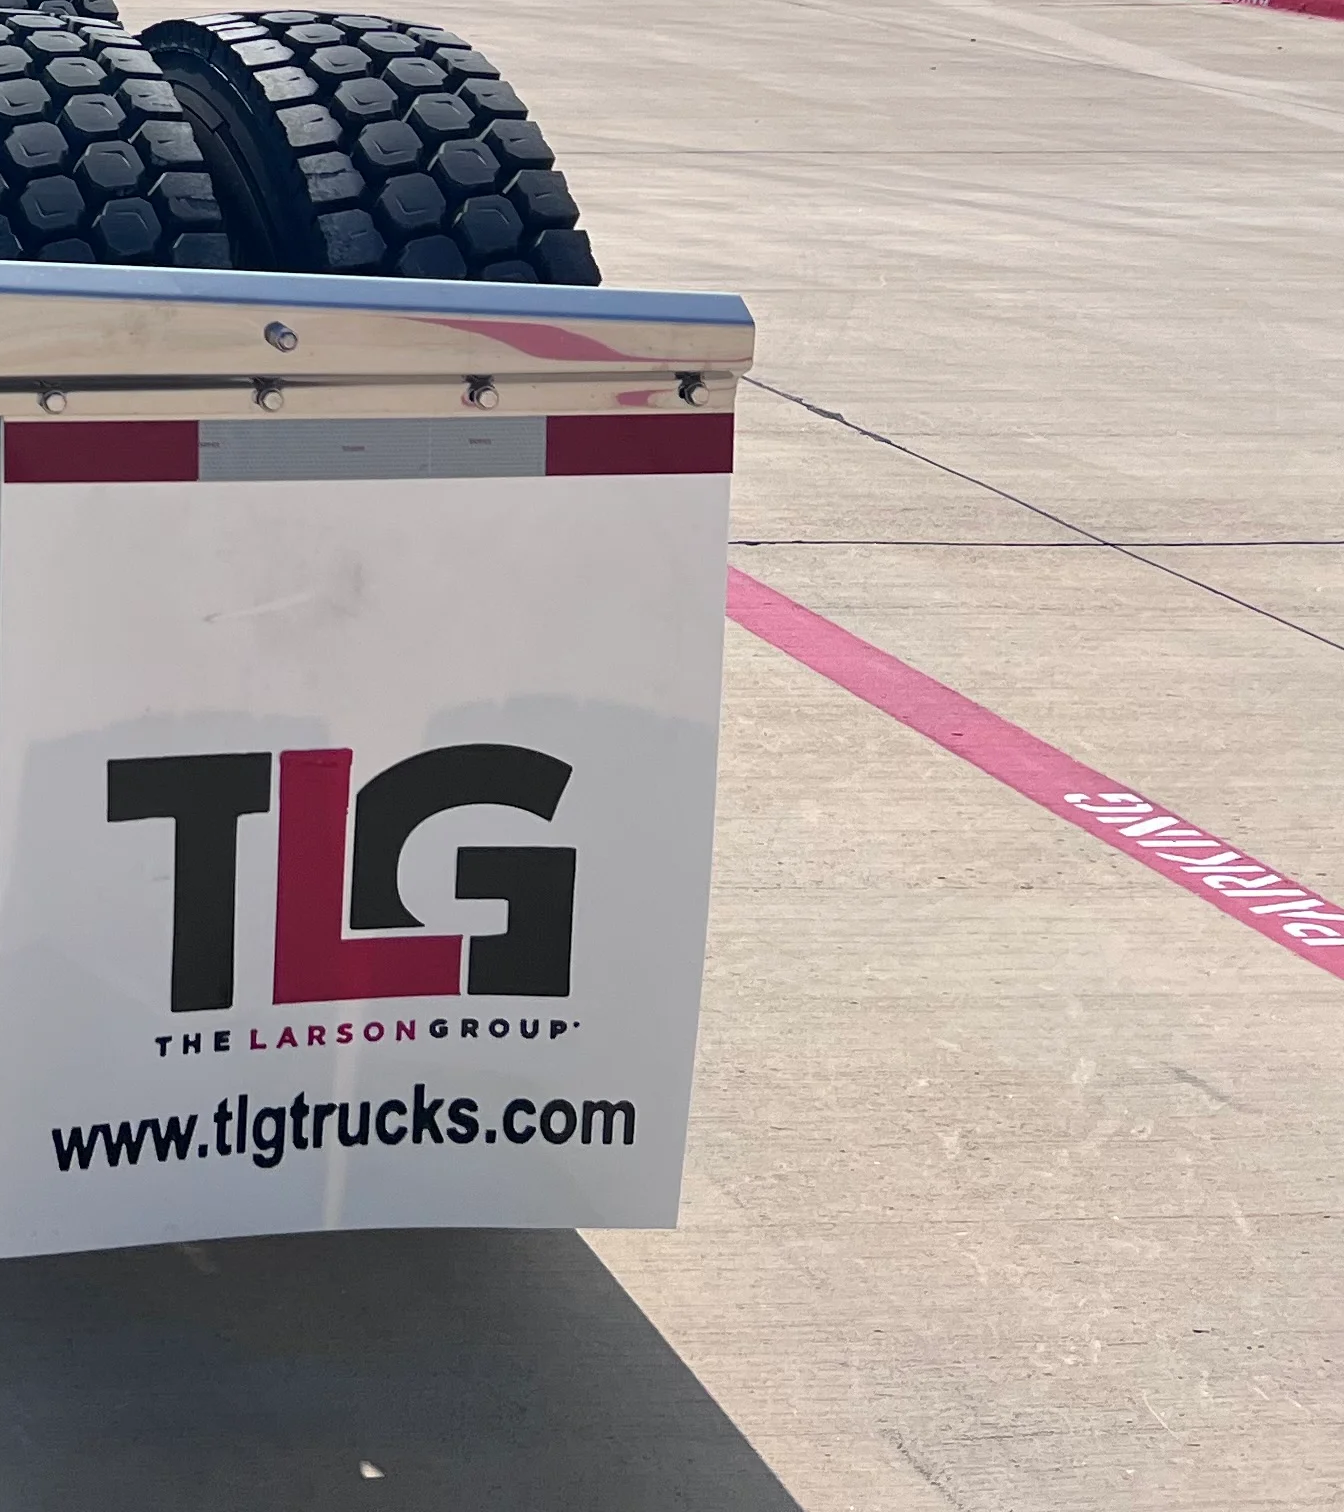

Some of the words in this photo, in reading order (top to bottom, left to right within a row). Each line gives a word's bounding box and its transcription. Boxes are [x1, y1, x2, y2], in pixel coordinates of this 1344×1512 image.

[106, 743, 578, 1014] TLG
[154, 1030, 232, 1058] THE
[51, 1083, 636, 1172] www.tlgtrucks.com
